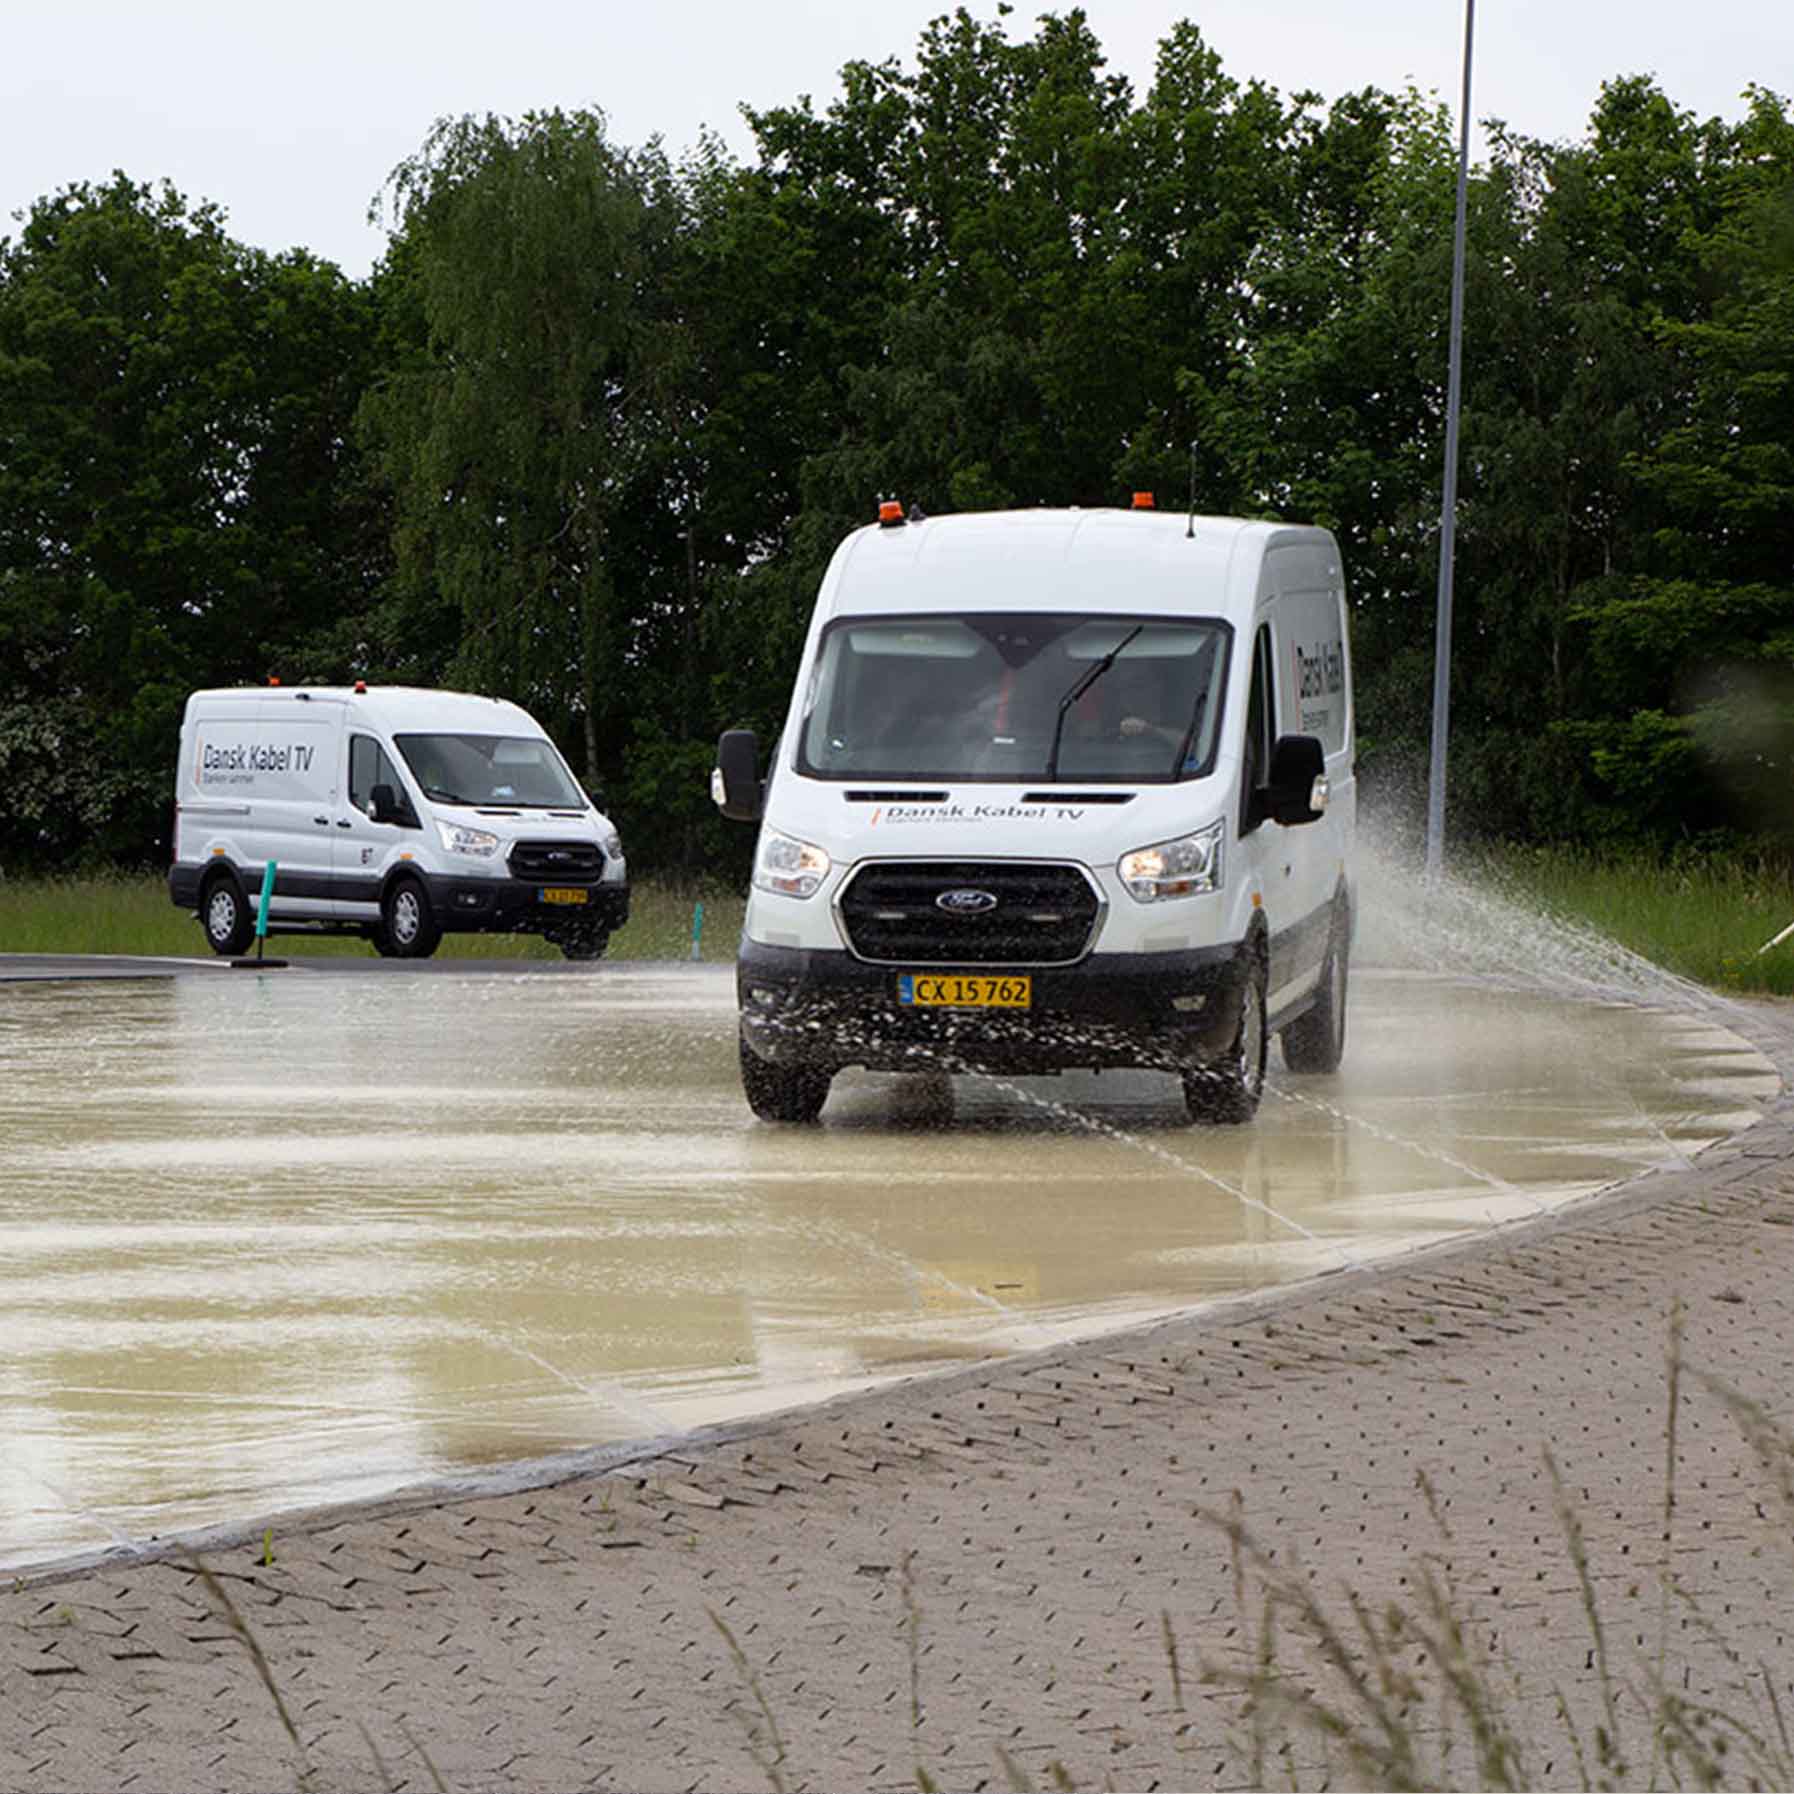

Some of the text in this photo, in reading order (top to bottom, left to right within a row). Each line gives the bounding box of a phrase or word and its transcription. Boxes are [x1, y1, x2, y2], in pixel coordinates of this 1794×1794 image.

[204, 743, 314, 771] Dansk Kabel TV
[886, 804, 1086, 821] Dansk Kabel TV
[945, 892, 986, 907] Ford
[916, 980, 946, 1001] CX
